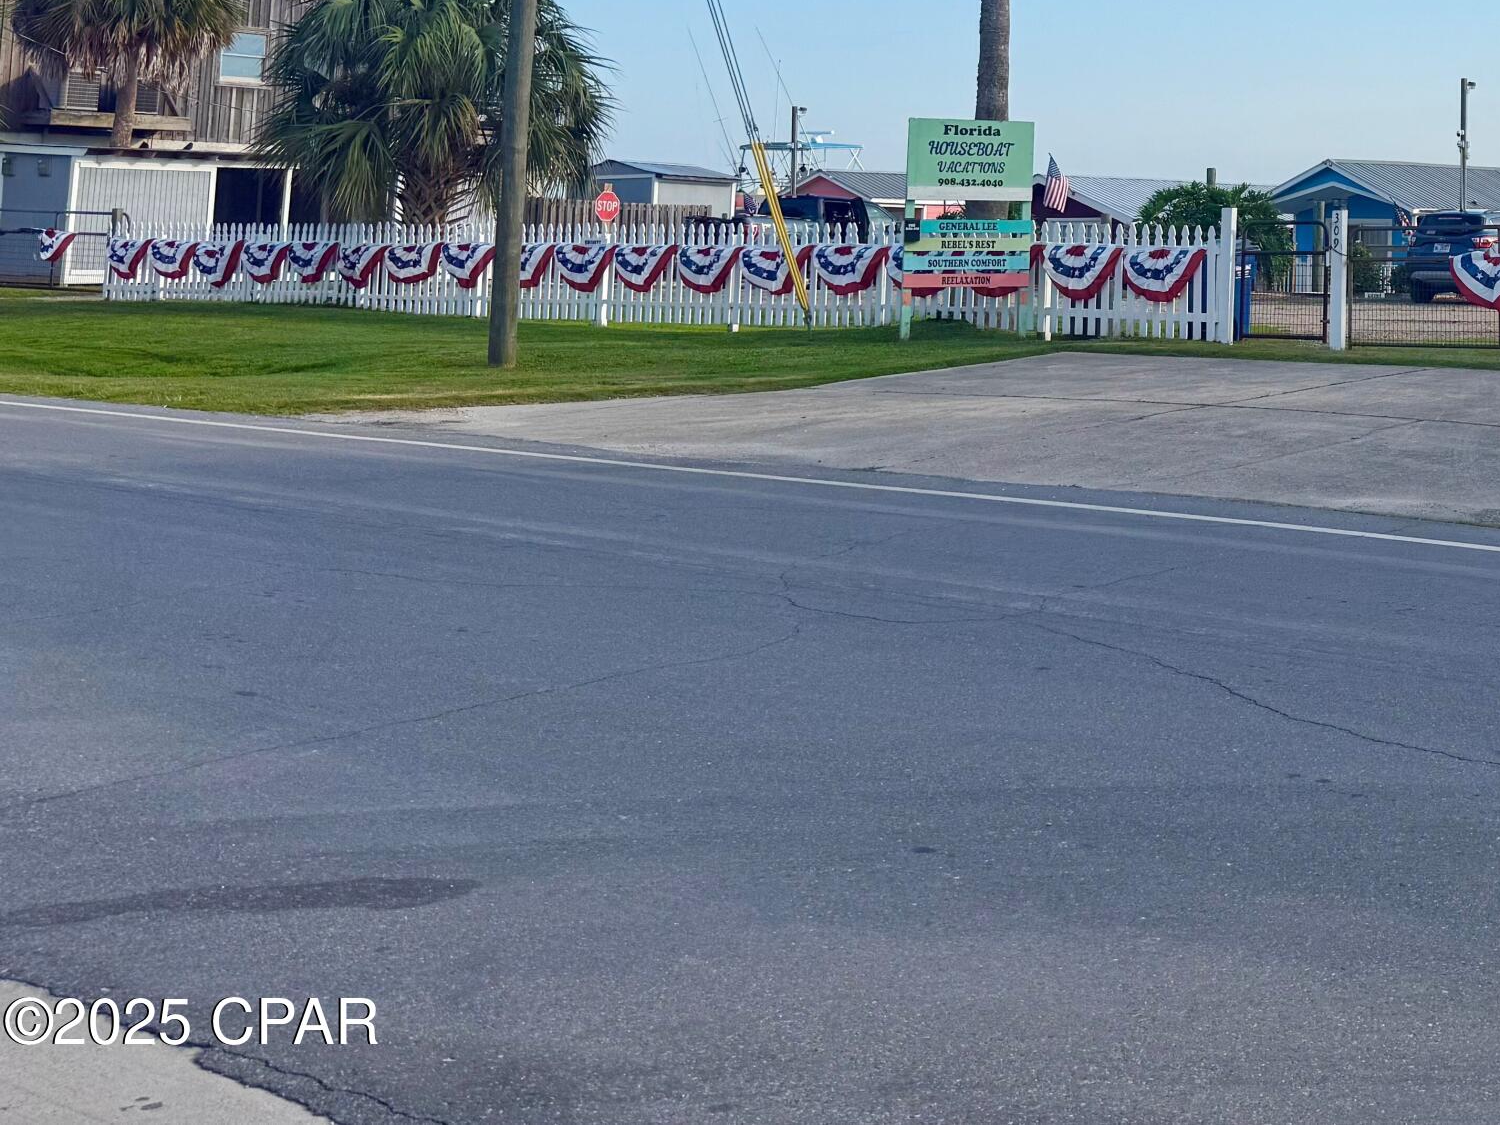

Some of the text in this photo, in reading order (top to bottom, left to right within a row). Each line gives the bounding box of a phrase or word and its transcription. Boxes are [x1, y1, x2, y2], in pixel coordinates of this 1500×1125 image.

[943, 124, 1001, 137] Florida
[928, 140, 1015, 157] HOUSEBOAT
[937, 161, 1006, 174] VACATIONS
[938, 178, 1004, 187] 908.432.4040
[597, 200, 618, 212] STOP
[938, 222, 998, 231] GENERAL LEE
[941, 240, 996, 250] REBEL'S REST
[927, 258, 1007, 268] SOUTHERN COMFORT
[941, 276, 991, 285] REELAXATION
